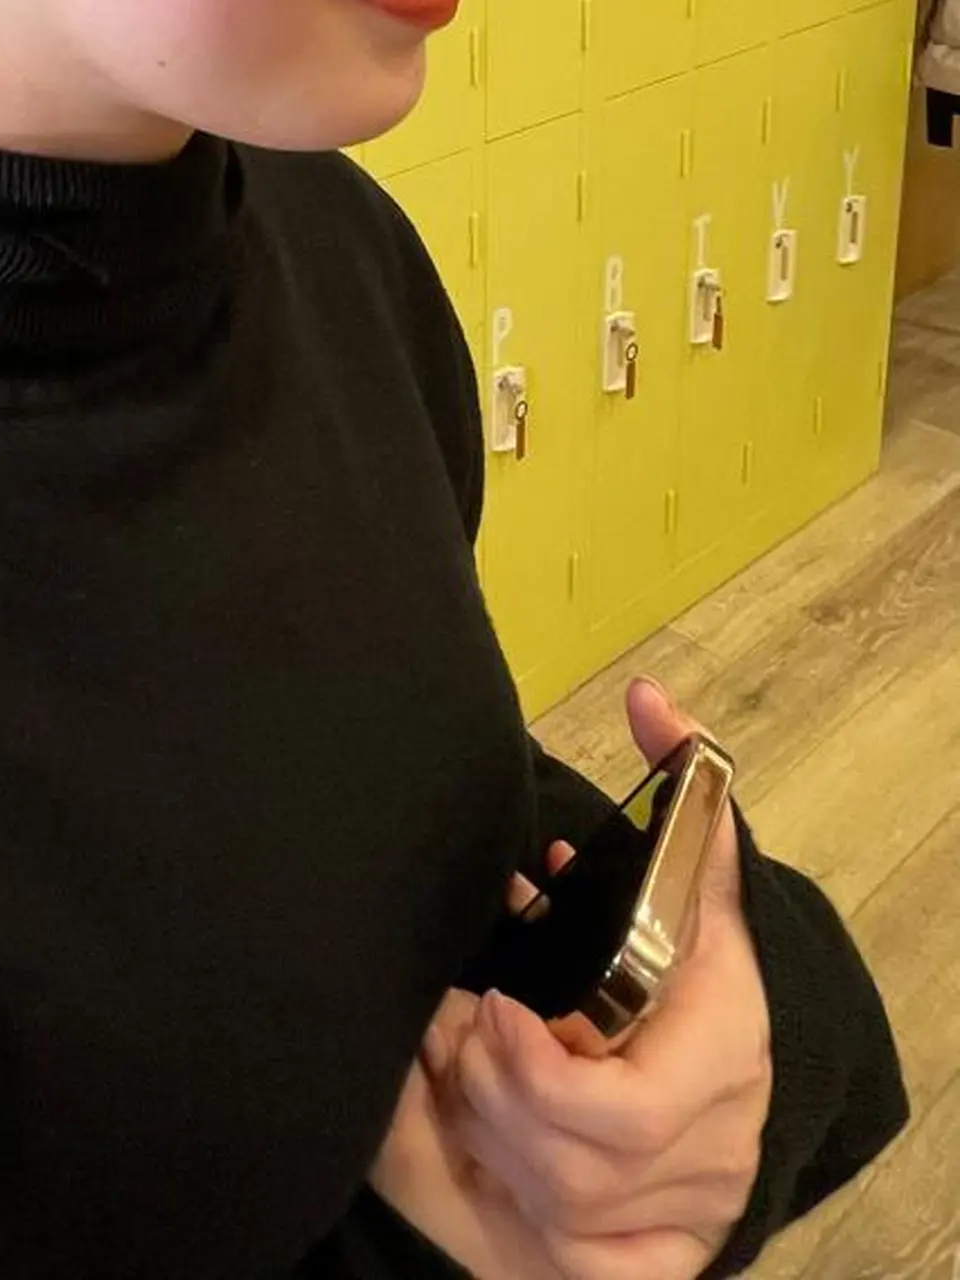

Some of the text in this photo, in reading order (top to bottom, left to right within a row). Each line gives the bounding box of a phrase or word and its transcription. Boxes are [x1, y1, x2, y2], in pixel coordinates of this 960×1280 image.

[843, 143, 860, 197] Y
[771, 174, 790, 229] V
[692, 213, 712, 267] T
[493, 307, 513, 366] P
